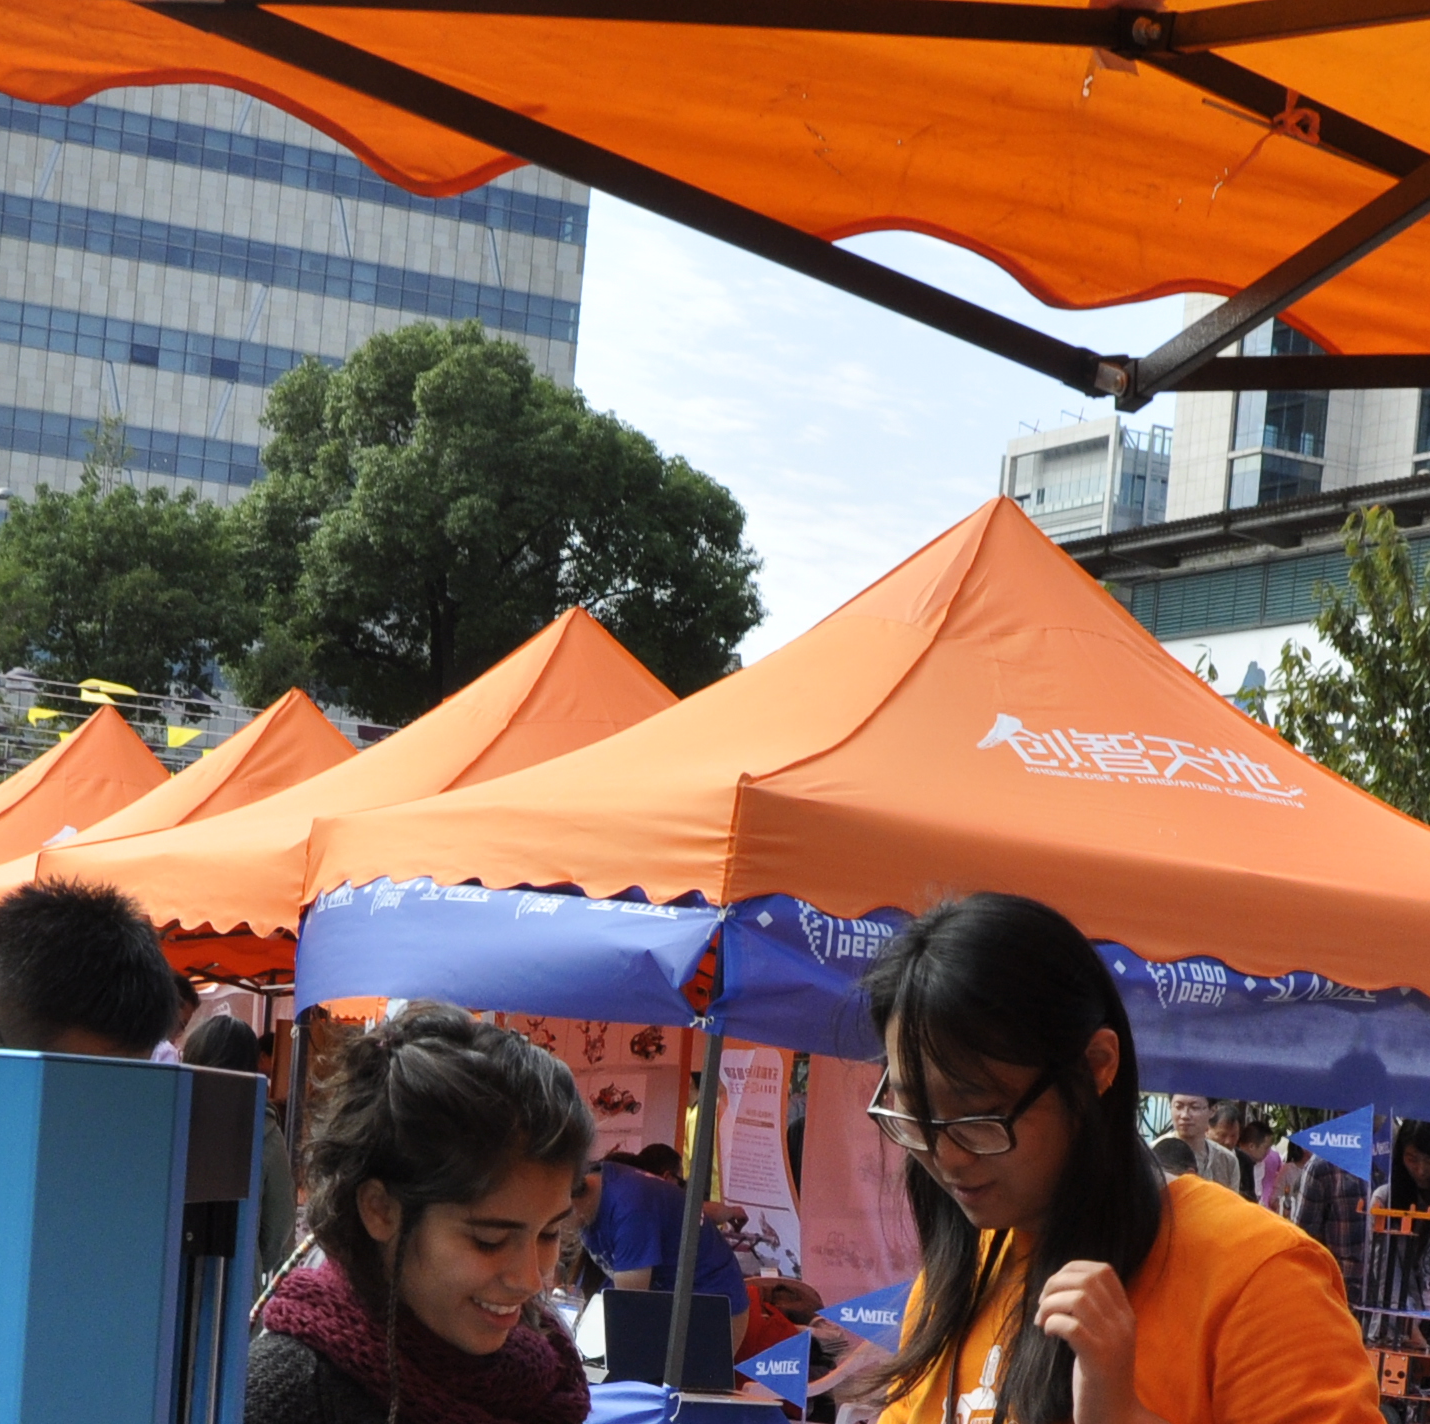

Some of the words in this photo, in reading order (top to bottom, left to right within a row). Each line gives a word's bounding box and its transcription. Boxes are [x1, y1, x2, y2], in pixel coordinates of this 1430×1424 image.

[1177, 961, 1227, 985] robo
[1177, 980, 1227, 1007] peak
[1309, 1131, 1362, 1148] SLAMTEC
[840, 1307, 899, 1325] SLAMTEC
[755, 1360, 800, 1376] SLAMTEC
